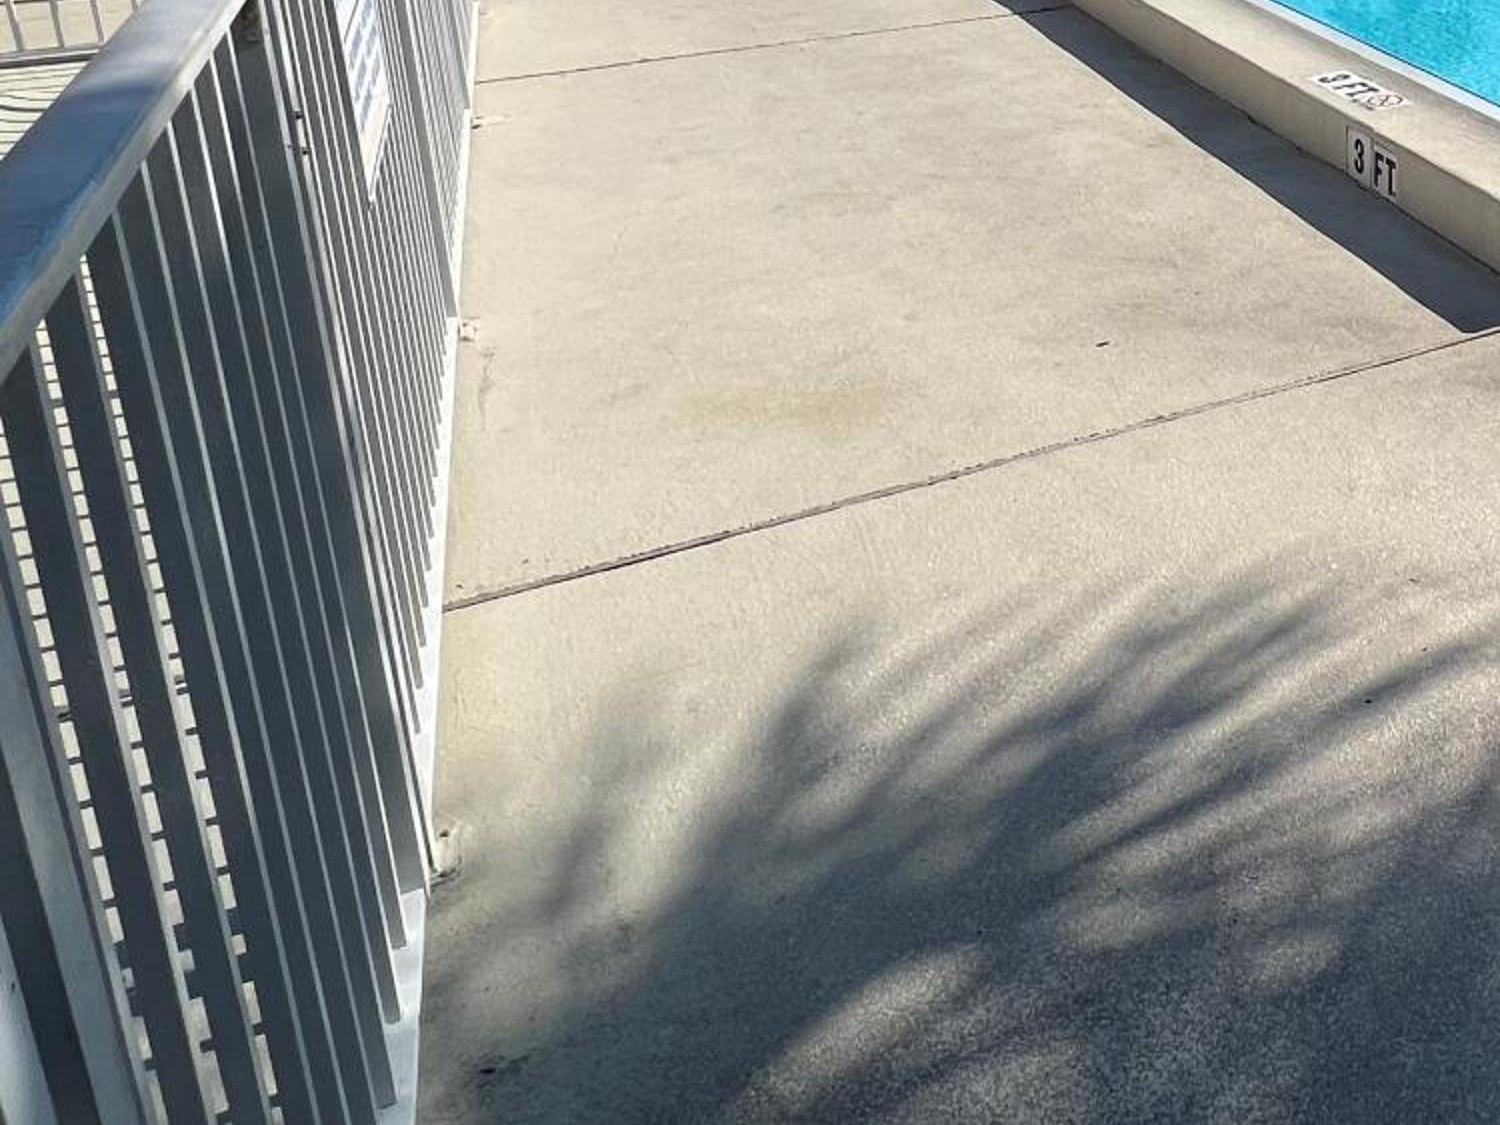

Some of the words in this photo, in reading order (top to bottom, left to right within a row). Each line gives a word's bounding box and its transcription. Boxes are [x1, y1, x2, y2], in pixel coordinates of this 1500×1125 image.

[1332, 82, 1380, 97] FT
[1353, 138, 1365, 175] 3
[1373, 150, 1397, 197] FT
